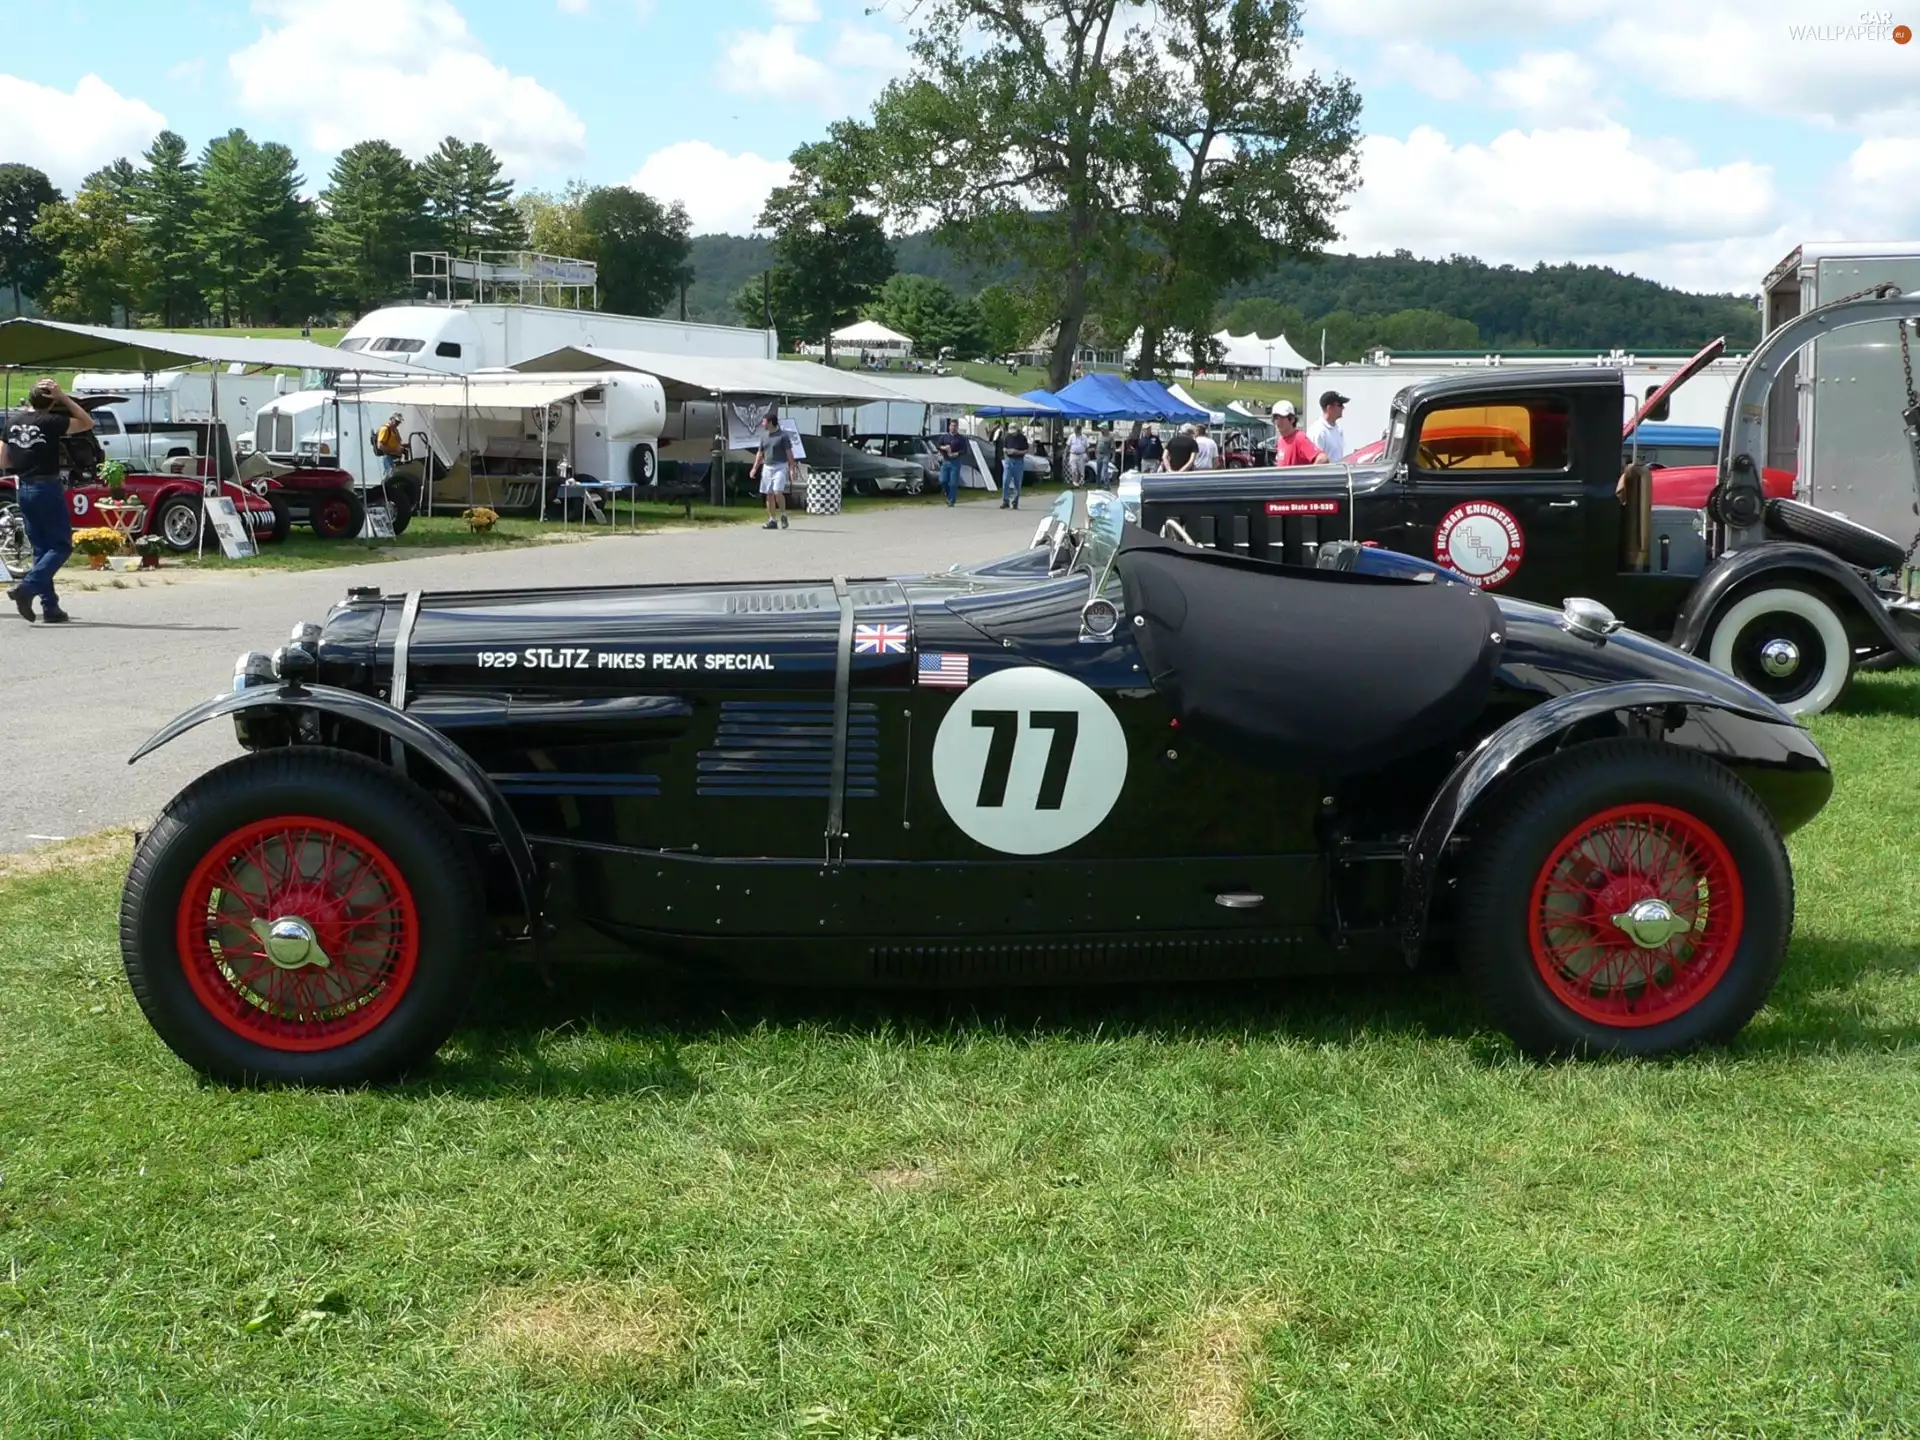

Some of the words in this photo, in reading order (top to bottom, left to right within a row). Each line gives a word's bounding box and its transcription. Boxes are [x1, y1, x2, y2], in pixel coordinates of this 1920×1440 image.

[73, 494, 89, 515] 9
[1465, 504, 1521, 549] ENGINEERING
[1483, 567, 1511, 585] TEAM
[476, 652, 518, 669] 1929
[523, 648, 590, 669] STUTZ
[597, 653, 646, 670] PIKES
[652, 653, 698, 670] PEAK
[704, 654, 775, 671] SPECIAL
[971, 710, 1079, 811] 77
